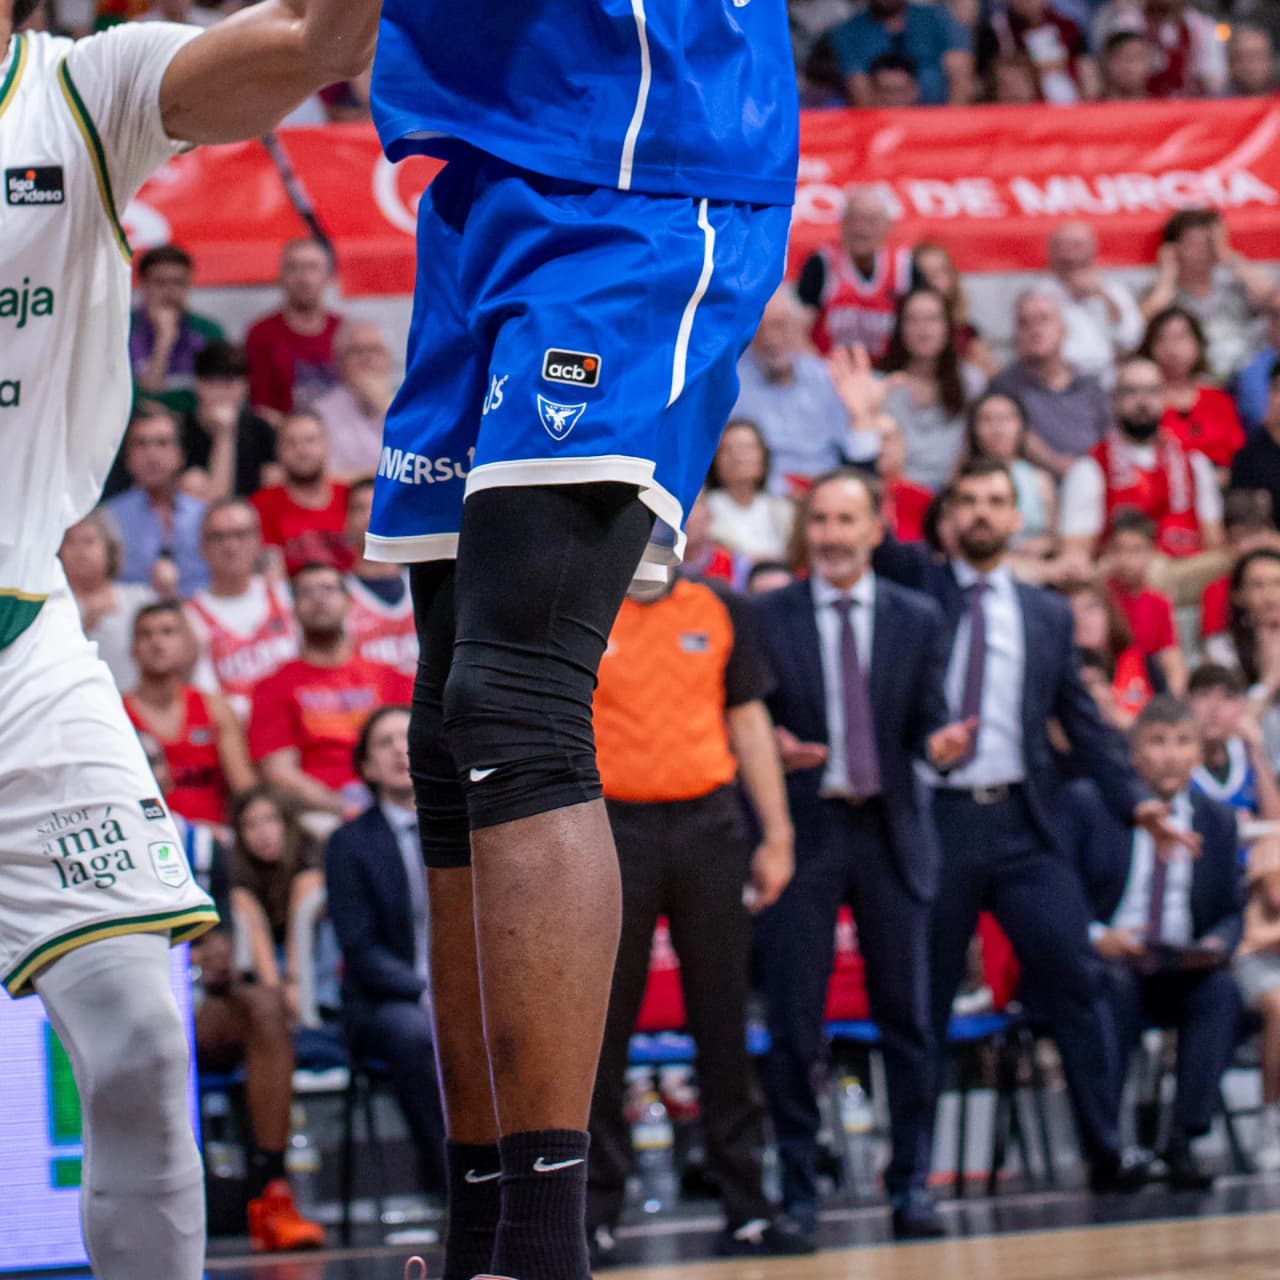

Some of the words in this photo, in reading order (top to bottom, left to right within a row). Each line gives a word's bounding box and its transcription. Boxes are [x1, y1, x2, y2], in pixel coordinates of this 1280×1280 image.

[908, 179, 1004, 220] DE
[1010, 169, 1278, 218] MURCIA
[548, 364, 586, 381] acb
[36, 807, 89, 835] sabor
[56, 806, 129, 858] má
[51, 848, 137, 889] laga
